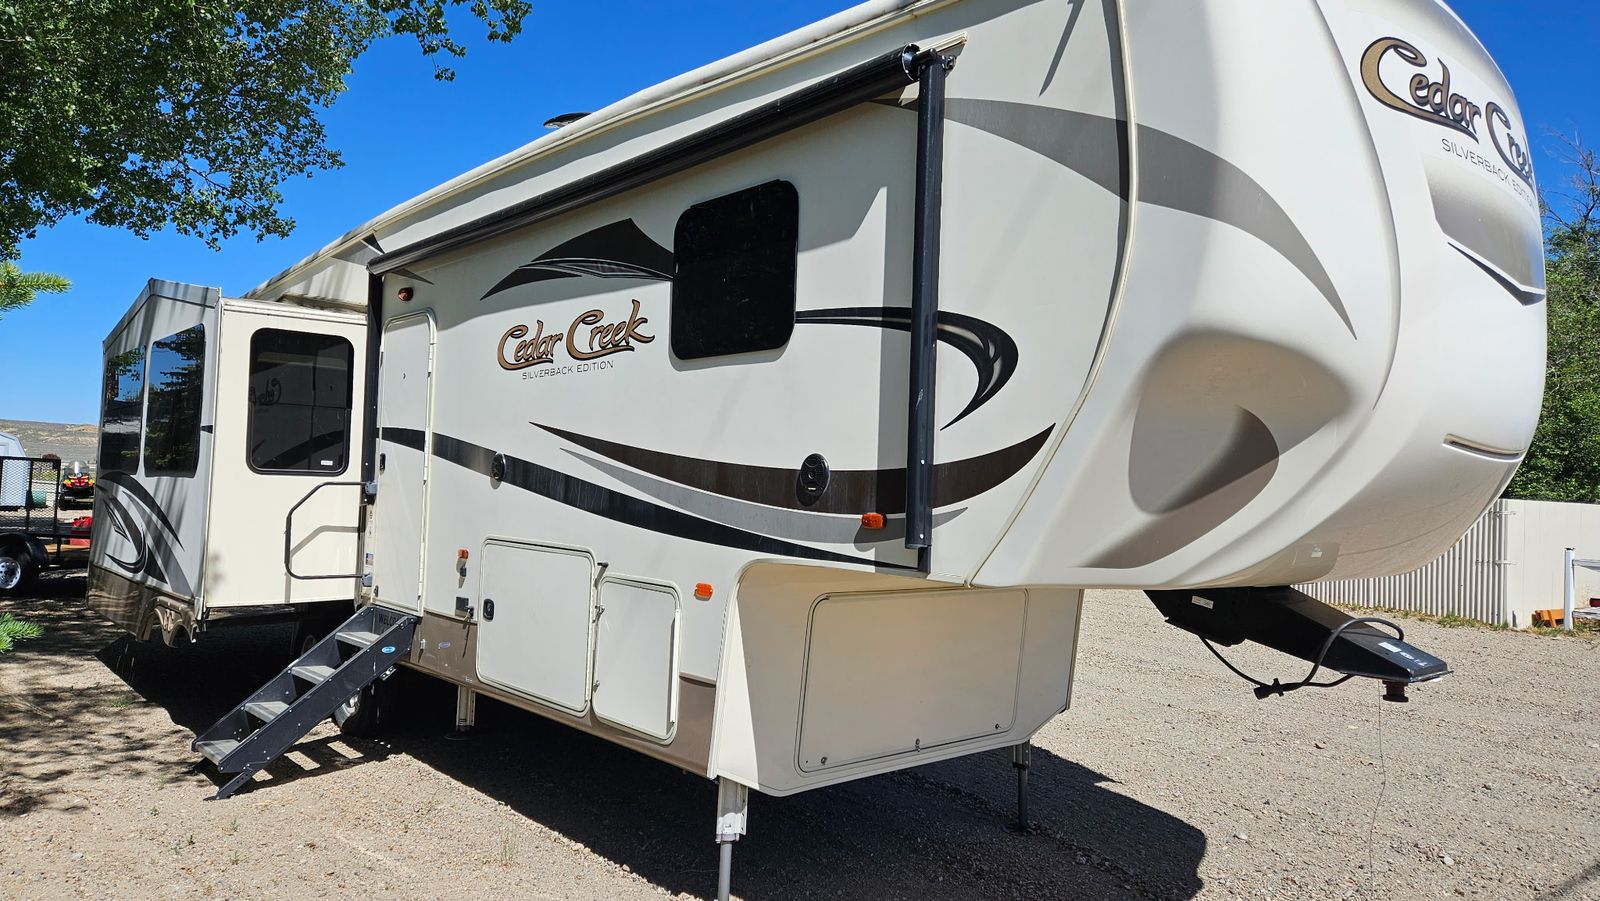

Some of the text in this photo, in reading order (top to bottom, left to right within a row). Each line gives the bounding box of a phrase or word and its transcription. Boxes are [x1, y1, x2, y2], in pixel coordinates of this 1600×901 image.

[1360, 37, 1482, 144] Cedar
[1441, 138, 1511, 186] SILVERBACK
[497, 299, 655, 371] Cedar Creek
[522, 360, 614, 380] SILVERBACK EDITION
